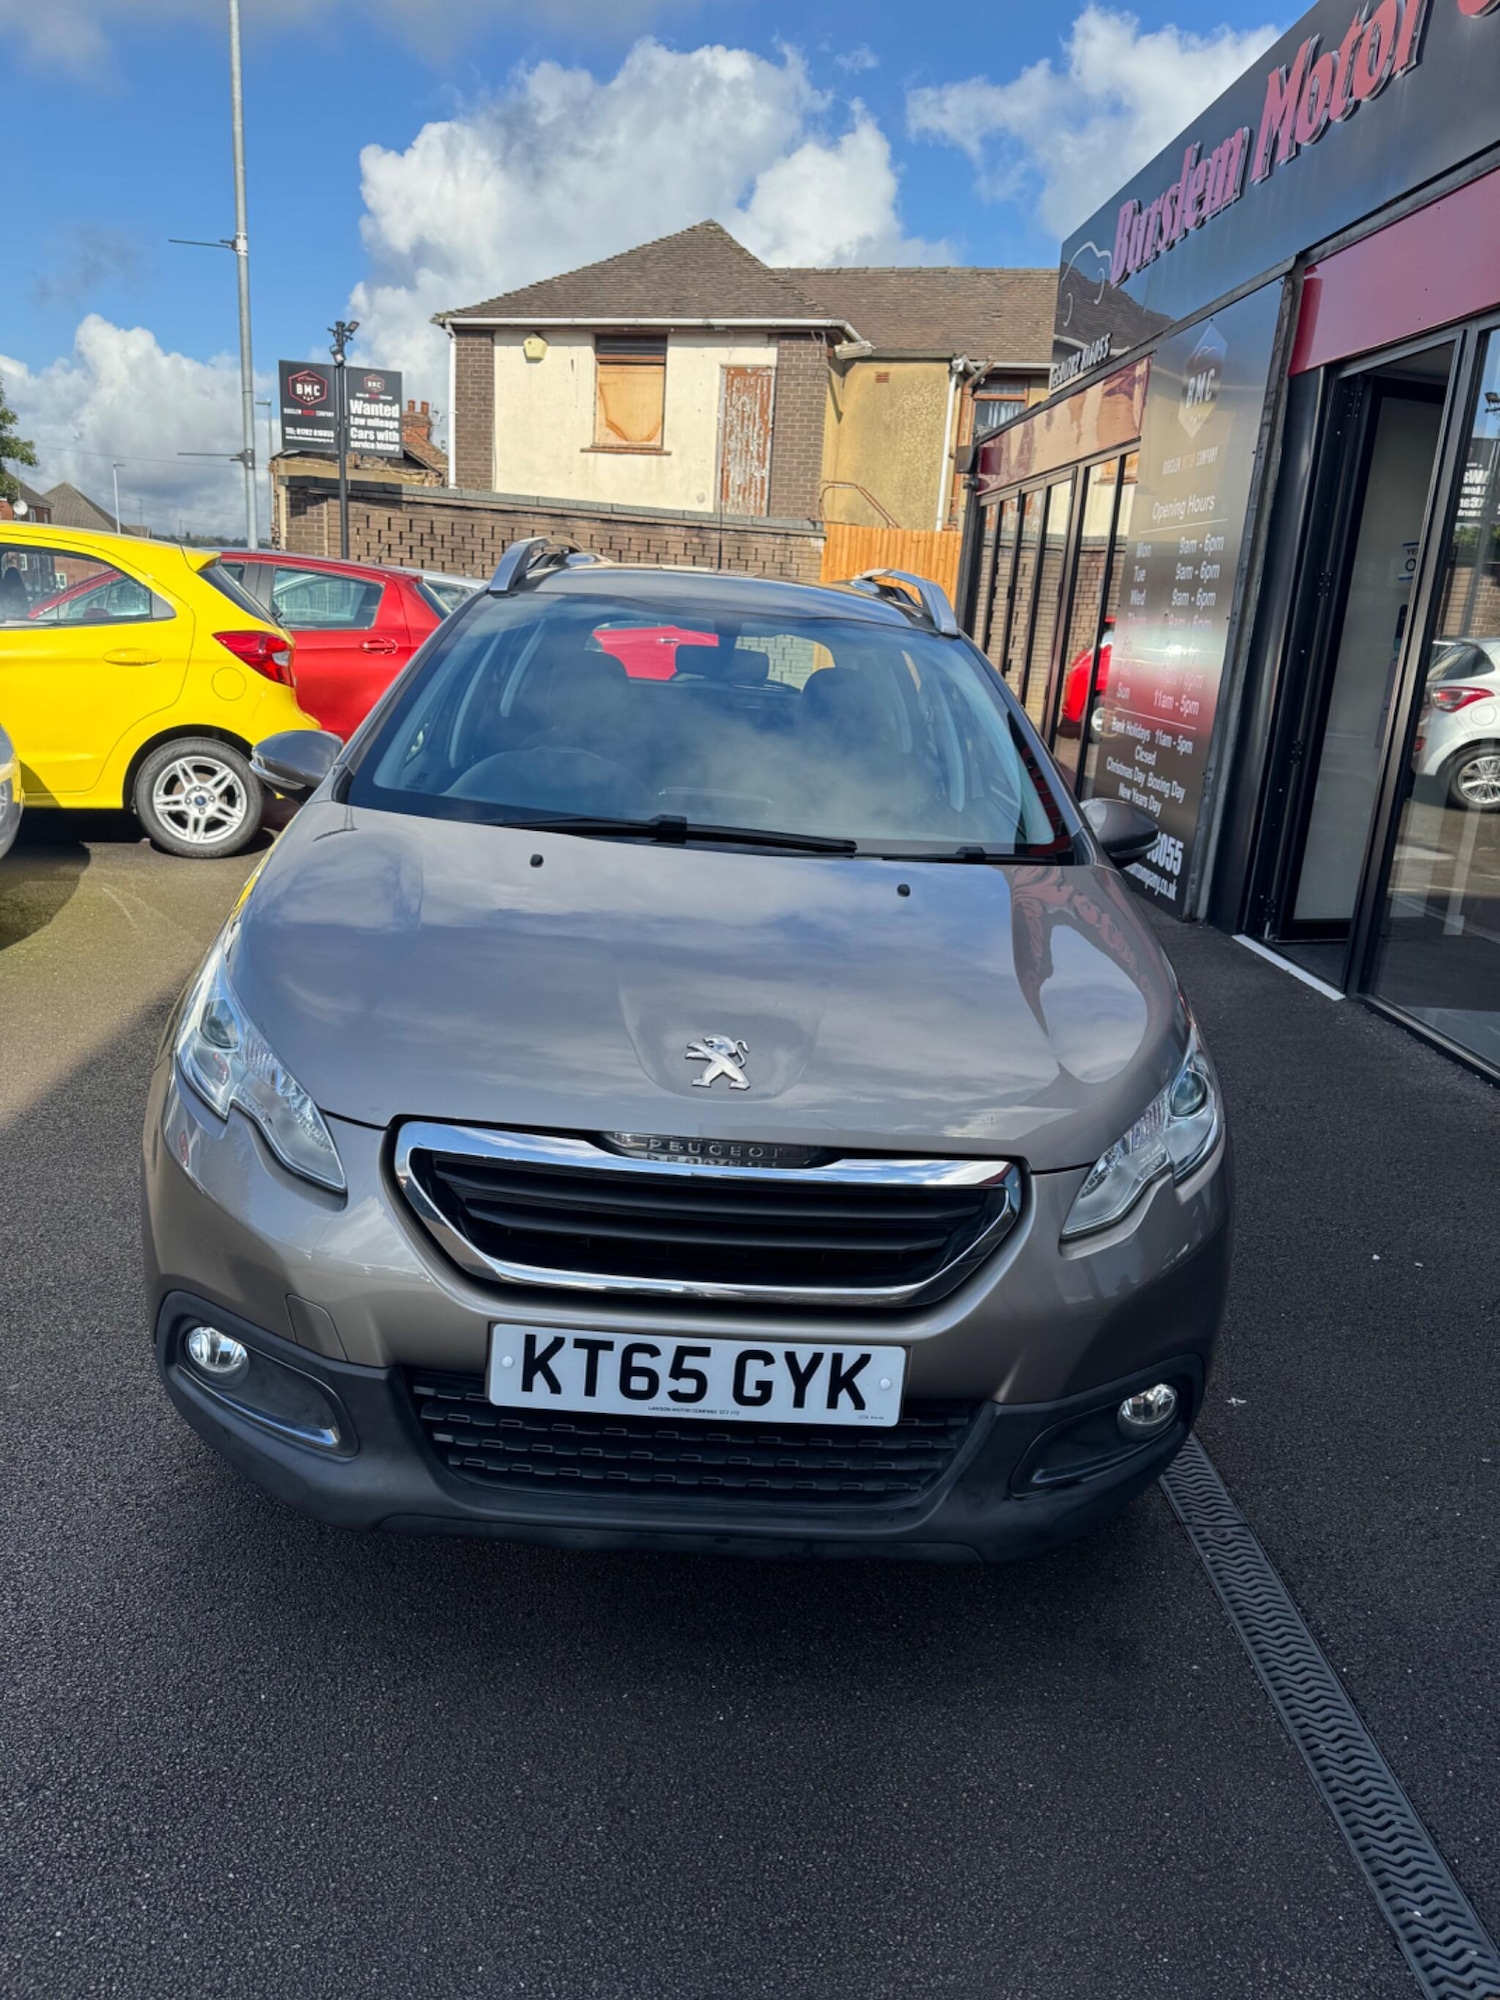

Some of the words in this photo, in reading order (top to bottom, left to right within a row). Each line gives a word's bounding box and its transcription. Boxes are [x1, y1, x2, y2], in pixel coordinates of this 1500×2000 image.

[1110, 126, 1249, 289] Burslem
[296, 383, 320, 396] BMC
[1186, 368, 1215, 408] BMC
[349, 399, 400, 418] Wanted
[350, 416, 366, 426] Low
[366, 418, 399, 430] mileage
[350, 427, 375, 440] Cars
[376, 430, 400, 443] with
[1152, 500, 1187, 523] Opening
[1187, 494, 1215, 515] Hours
[1136, 542, 1151, 558] Mon
[1179, 536, 1197, 554] 9am
[1204, 533, 1224, 556] 6pm
[1134, 565, 1146, 582] Tue
[1176, 562, 1193, 580] 9am
[1200, 560, 1220, 583] 6pm
[1130, 588, 1146, 606] Wed
[1172, 588, 1189, 606] 9am
[1196, 587, 1216, 611] 6pm
[1116, 682, 1130, 699] Sun
[1154, 689, 1174, 710] 11am
[1180, 694, 1199, 717] 5pm
[1112, 716, 1126, 734] Bank
[1126, 719, 1151, 744] Holidays
[1155, 728, 1172, 748] 11am
[1177, 735, 1193, 756] 5pm
[1135, 745, 1157, 766] Closed
[1106, 756, 1133, 780] Christmas
[1133, 766, 1146, 788] Day
[1147, 771, 1171, 798] Boxing
[1171, 780, 1186, 804] Day
[1118, 782, 1132, 801] New
[1132, 787, 1148, 808] Years
[1148, 794, 1162, 818] Day
[520, 1333, 711, 1403] KT65
[732, 1349, 872, 1410] GYK
